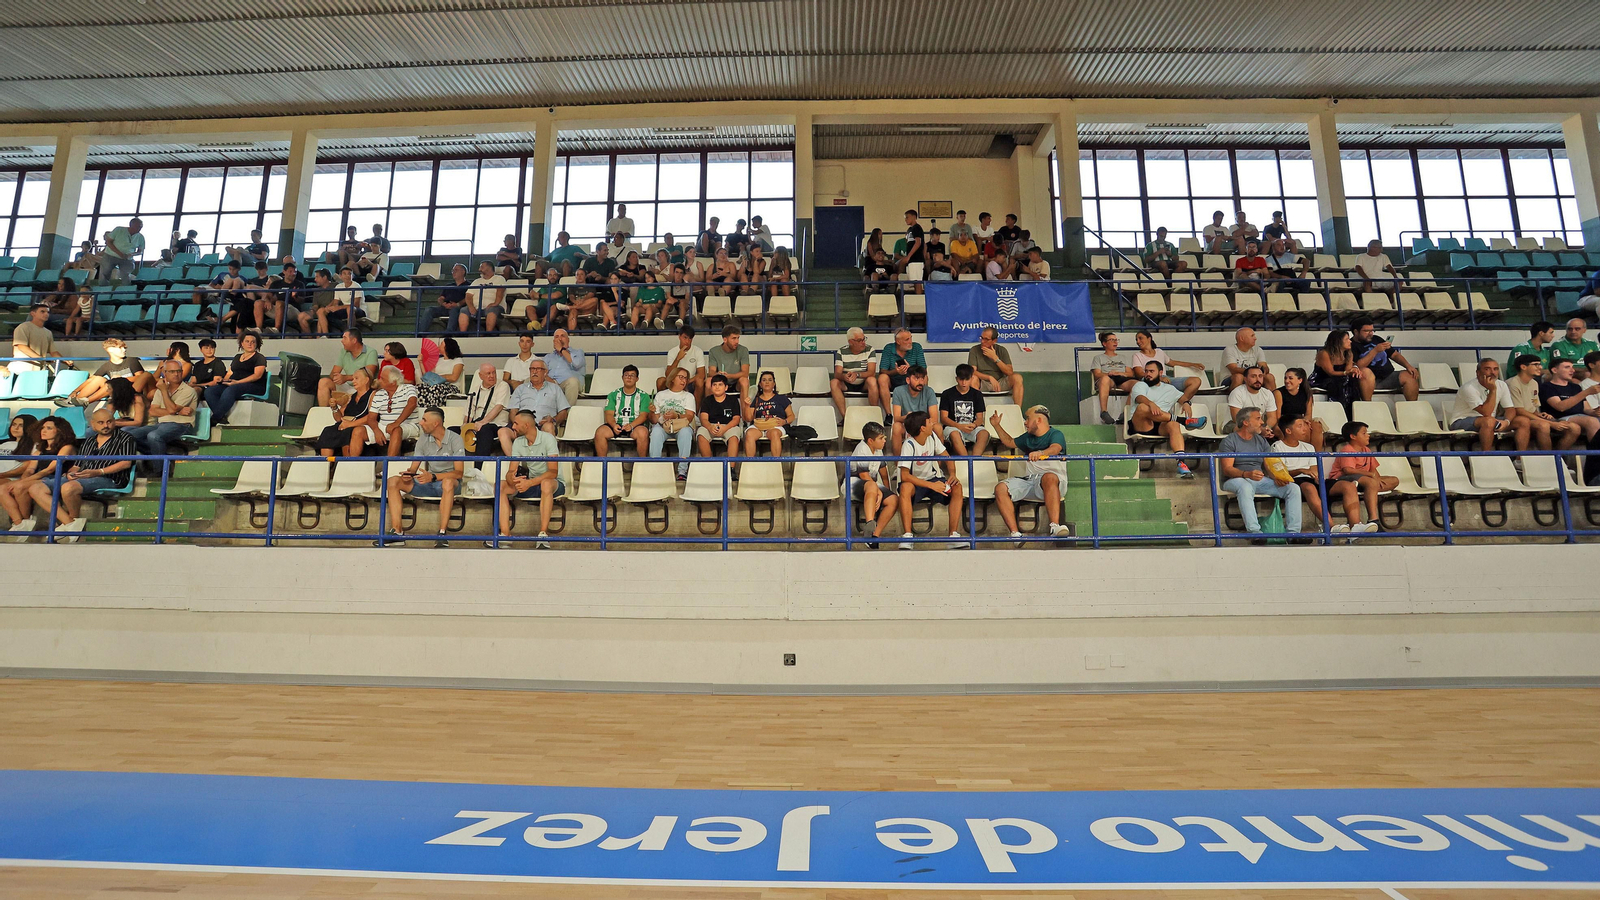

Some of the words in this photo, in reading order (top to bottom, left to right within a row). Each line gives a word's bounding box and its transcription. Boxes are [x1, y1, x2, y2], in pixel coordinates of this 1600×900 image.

[953, 321, 1026, 332] Ayuntamiento
[1027, 322, 1041, 330] de
[1042, 321, 1068, 331] Jerez
[425, 806, 830, 871] Jerez
[876, 818, 1057, 873] de
